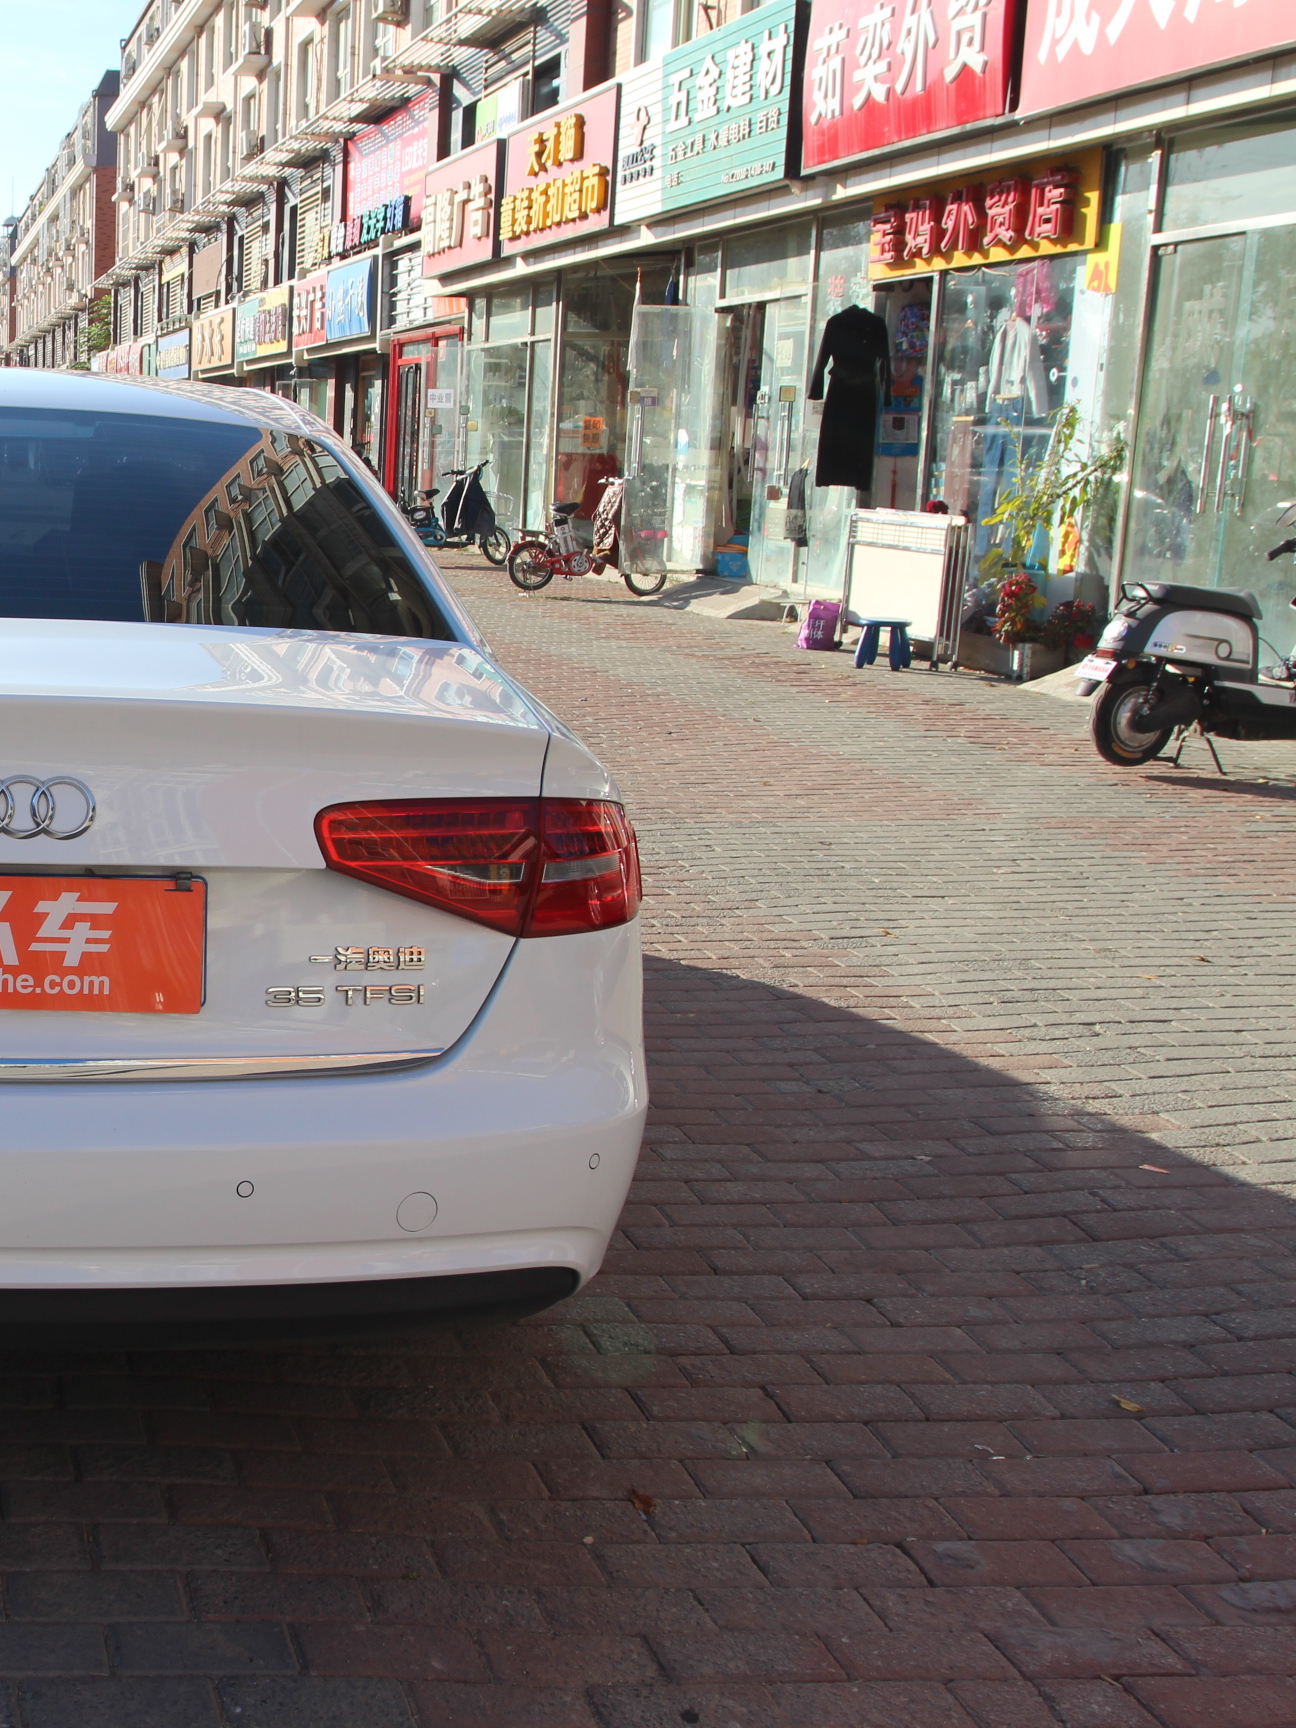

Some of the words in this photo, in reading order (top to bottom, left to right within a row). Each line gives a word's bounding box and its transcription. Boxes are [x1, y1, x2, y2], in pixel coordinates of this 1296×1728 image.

[665, 22, 789, 134] 五金建材
[667, 133, 705, 165] 五金工具
[757, 107, 781, 134] 百货
[500, 163, 608, 241] 童装折扣超市
[869, 168, 1078, 264] 宝妈外贸店
[583, 418, 602, 431] 复印
[309, 945, 426, 971] 一汽奥迪
[265, 985, 326, 1007] 35
[335, 984, 426, 1006] TFSI
